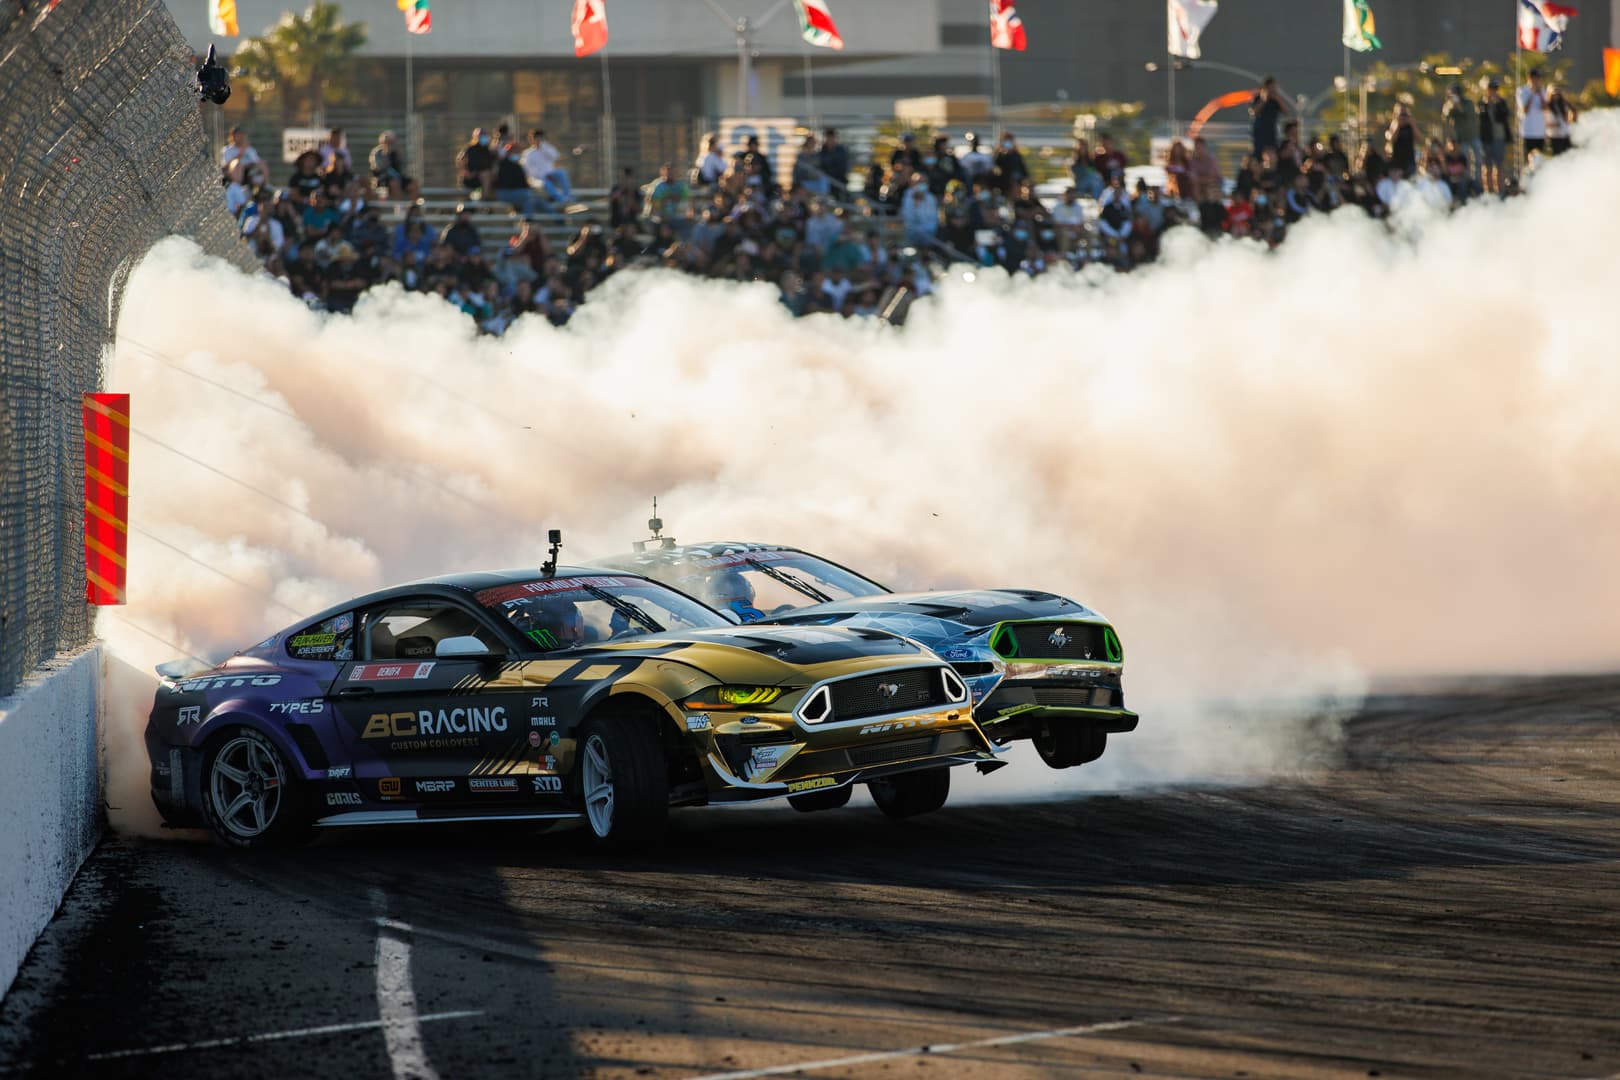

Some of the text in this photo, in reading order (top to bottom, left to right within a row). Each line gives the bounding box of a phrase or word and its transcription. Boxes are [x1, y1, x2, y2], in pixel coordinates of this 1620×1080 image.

[949, 650, 968, 659] Ford
[170, 674, 282, 694] NITTO
[531, 697, 549, 707] RTR
[177, 705, 201, 726] RTR
[531, 716, 556, 727] MAHLE
[361, 706, 508, 739] BC RACING
[859, 716, 937, 735] NITTO
[391, 737, 480, 750] CUSTOM COILOVERS
[416, 780, 456, 793] MBRP
[470, 779, 498, 788] CENTER
[788, 777, 839, 792] PENNZOIL
